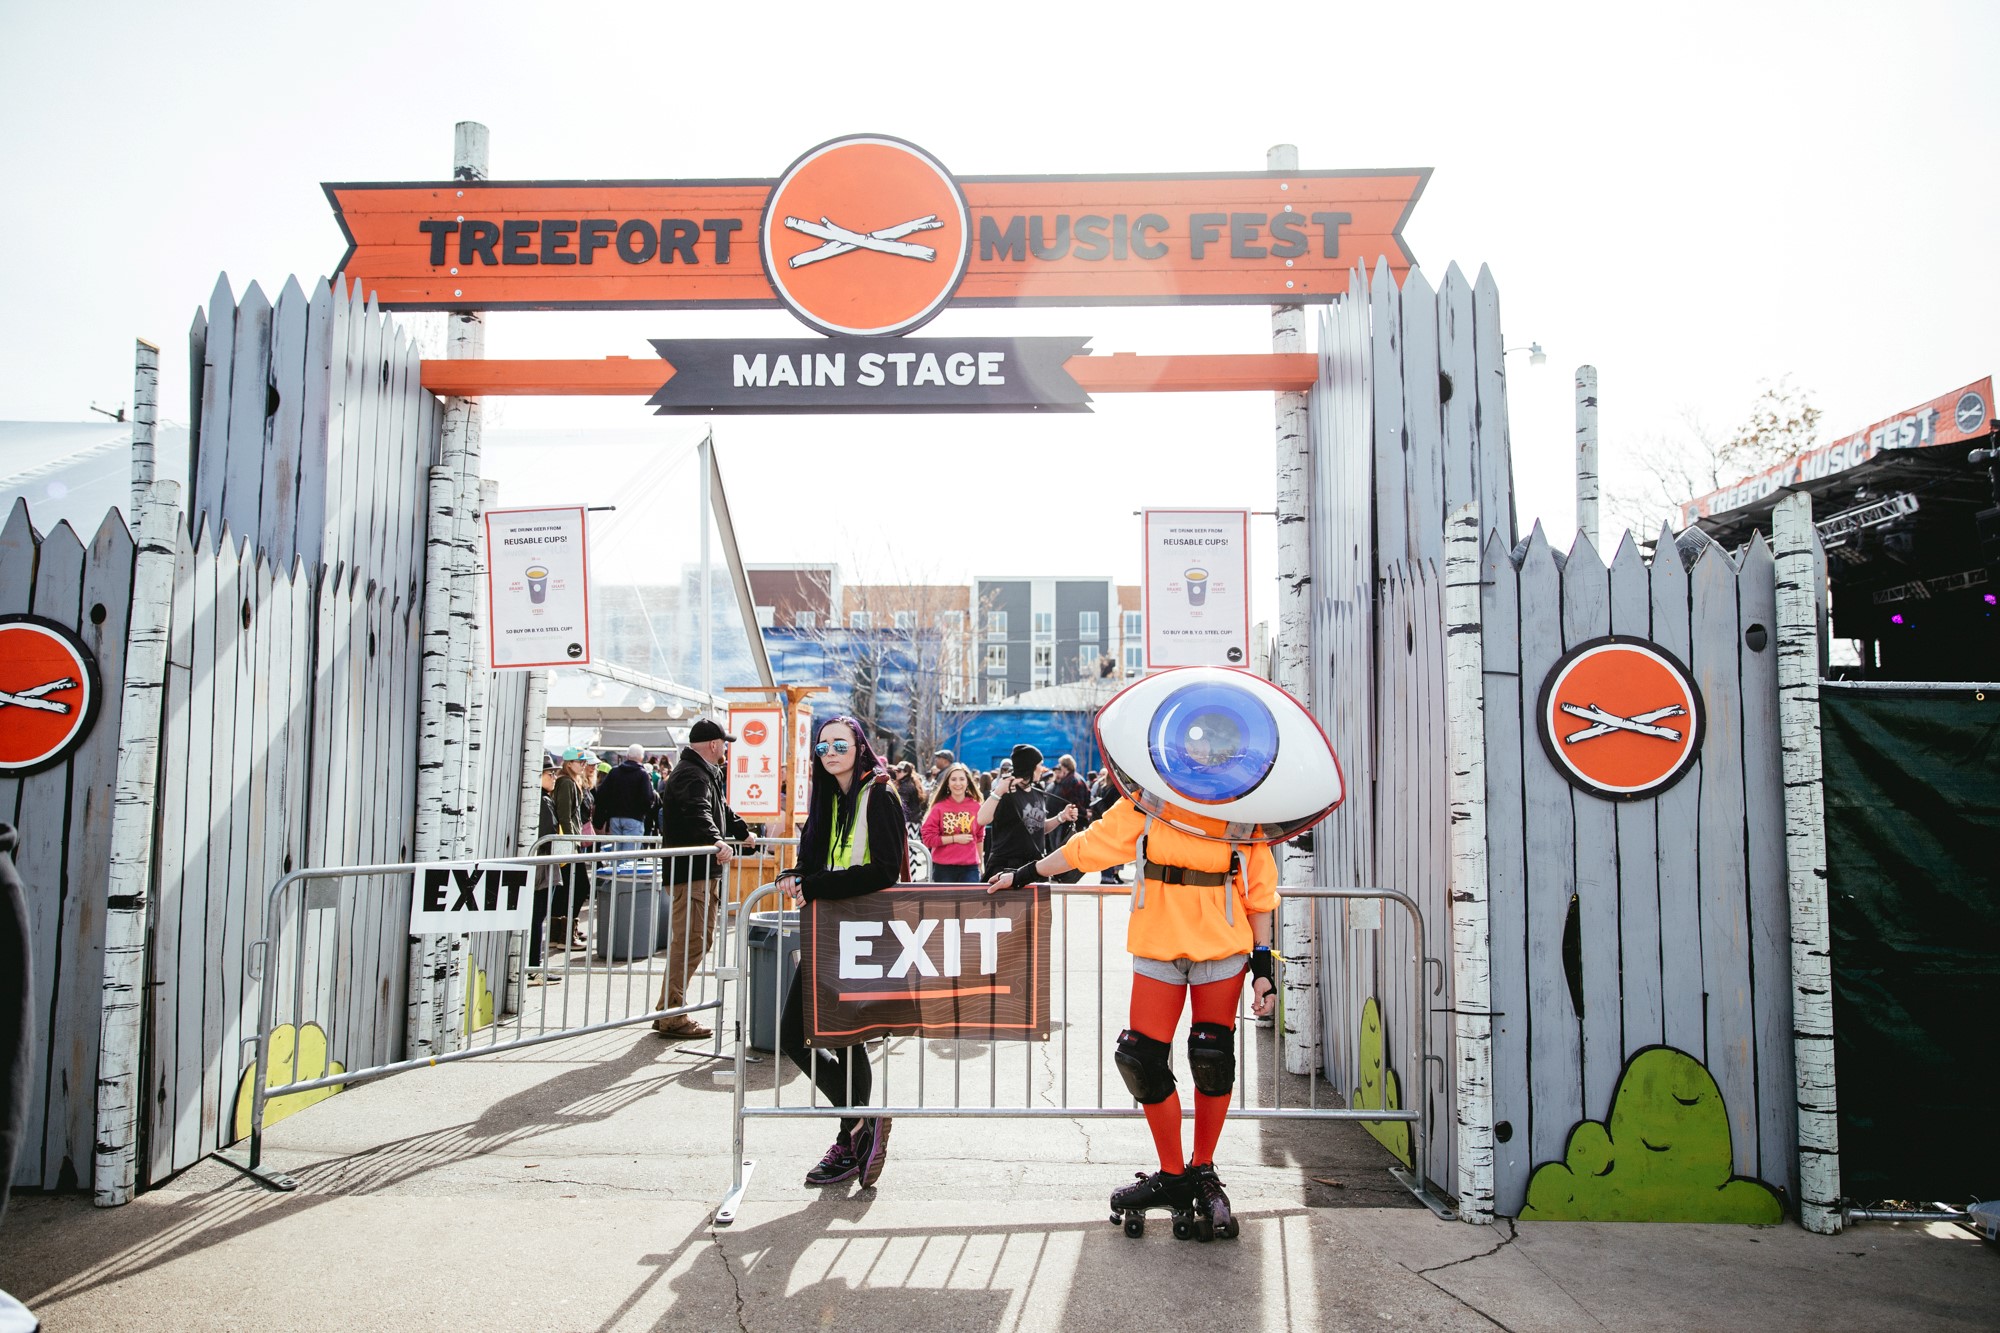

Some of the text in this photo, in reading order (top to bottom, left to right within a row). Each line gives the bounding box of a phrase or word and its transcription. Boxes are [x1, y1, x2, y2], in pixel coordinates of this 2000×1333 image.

[419, 212, 1352, 267] TREEFORT MUSIC FEST
[733, 351, 1005, 388] MAIN STAGE
[1707, 408, 1934, 515] TREEFORT MUSIC FEST
[504, 535, 568, 546] REUSABLE CUPS!
[943, 811, 975, 835] MTV
[423, 868, 529, 912] EXIT
[839, 918, 1012, 979] EXIT
